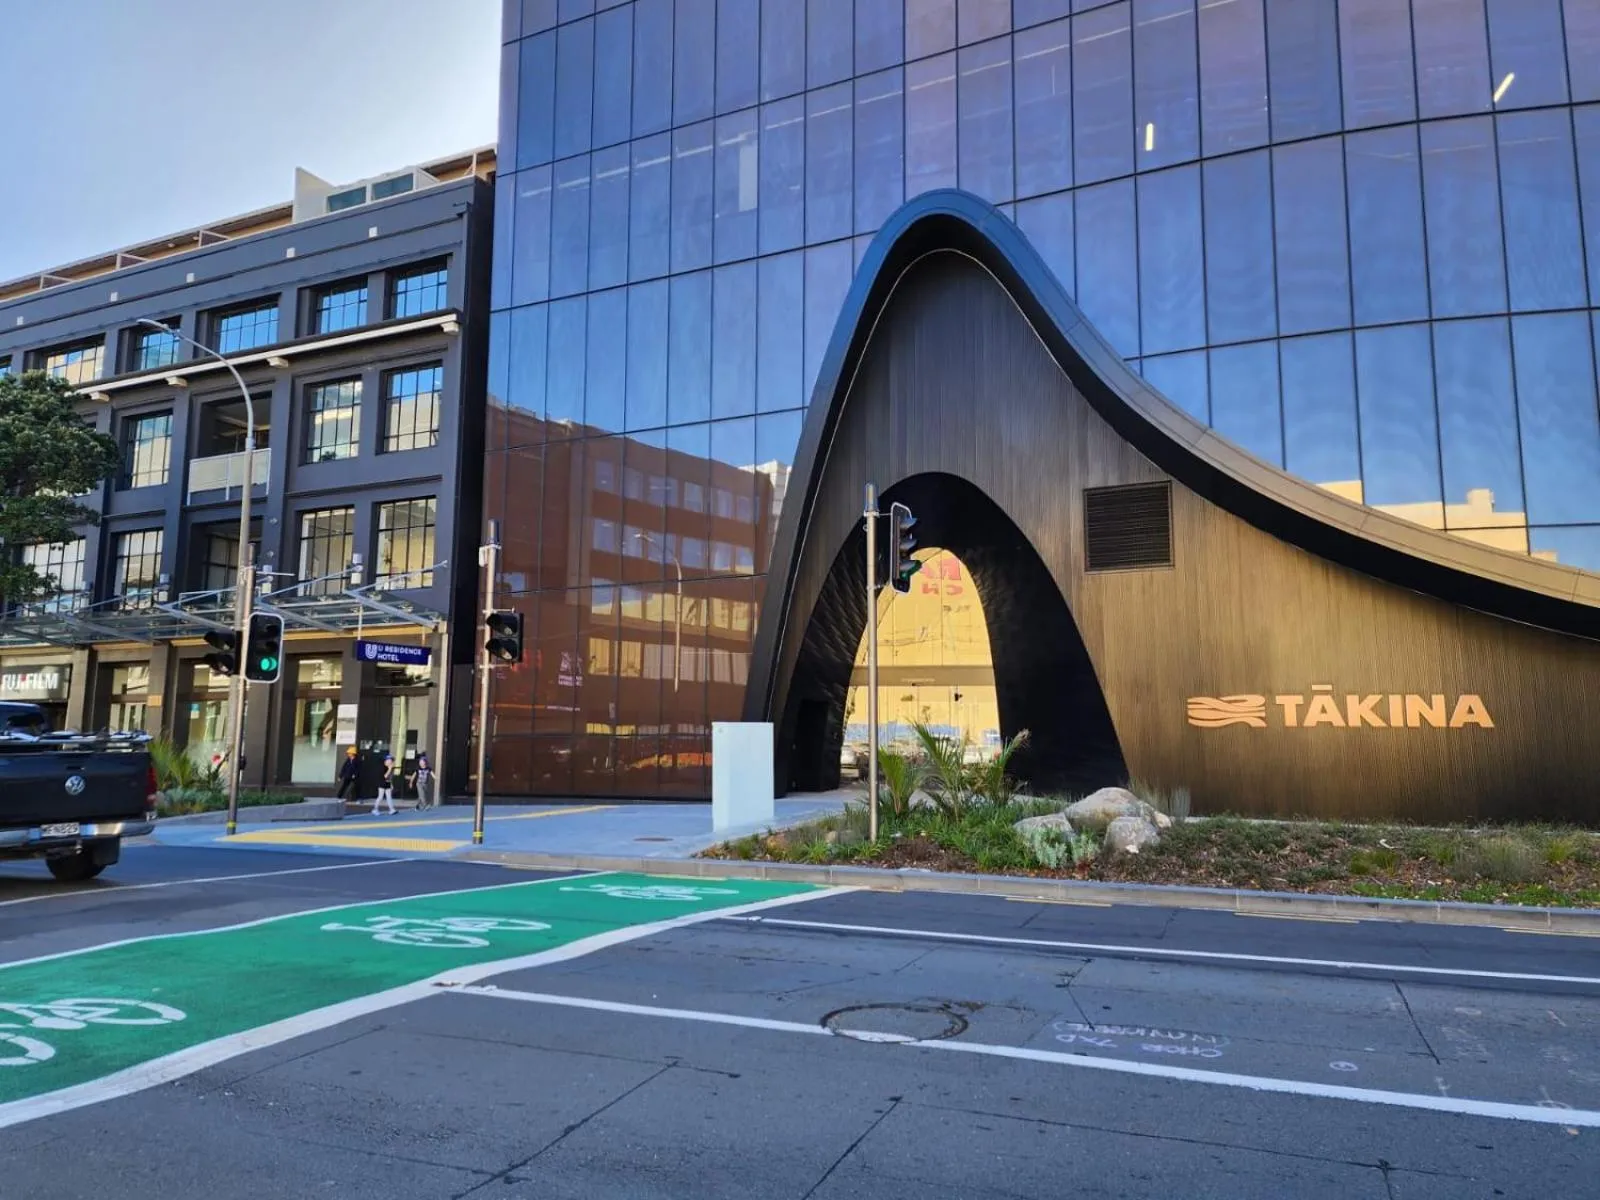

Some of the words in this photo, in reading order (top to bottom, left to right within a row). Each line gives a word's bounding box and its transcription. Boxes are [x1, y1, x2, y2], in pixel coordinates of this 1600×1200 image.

[378, 653, 400, 661] HOTEL
[385, 645, 422, 655] RESIDENCE
[1, 672, 59, 691] FUJIFILM
[1275, 684, 1495, 729] TĀKINA
